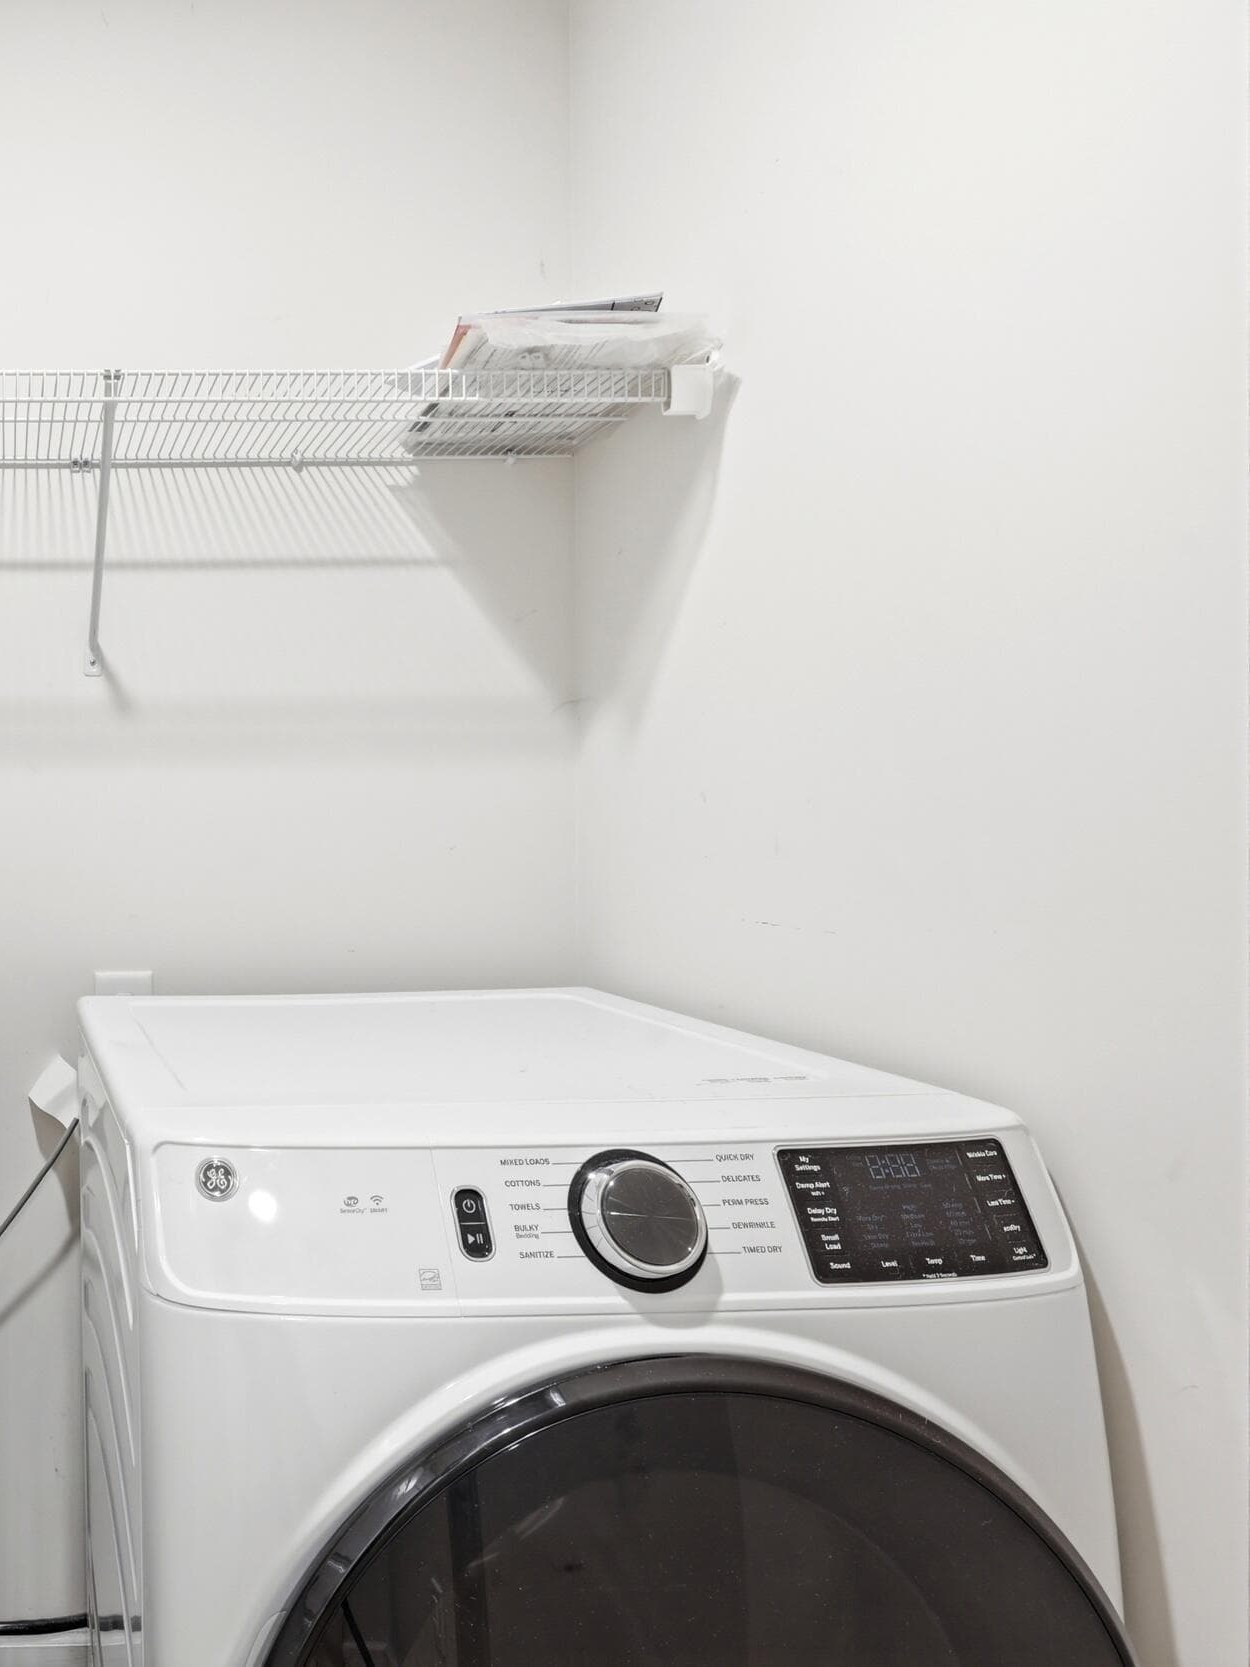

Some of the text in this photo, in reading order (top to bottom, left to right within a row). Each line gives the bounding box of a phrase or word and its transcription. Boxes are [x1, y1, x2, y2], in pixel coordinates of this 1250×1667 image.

[500, 1158, 550, 1166] MIXED LOADS
[716, 1154, 738, 1162] QUICK
[794, 1164, 821, 1172] Settings
[721, 1174, 761, 1182] DELICATES
[504, 1180, 541, 1188] COTTONS
[795, 1182, 814, 1190] Damp
[722, 1198, 770, 1206] PERM PRESS
[510, 1202, 541, 1211] TOWELS
[514, 1224, 539, 1232] BULKY
[742, 1246, 766, 1254] TIMED
[519, 1250, 554, 1259] SANITIZE
[970, 1254, 986, 1262] Time
[830, 1262, 852, 1270] Sound
[881, 1260, 898, 1268] Level
